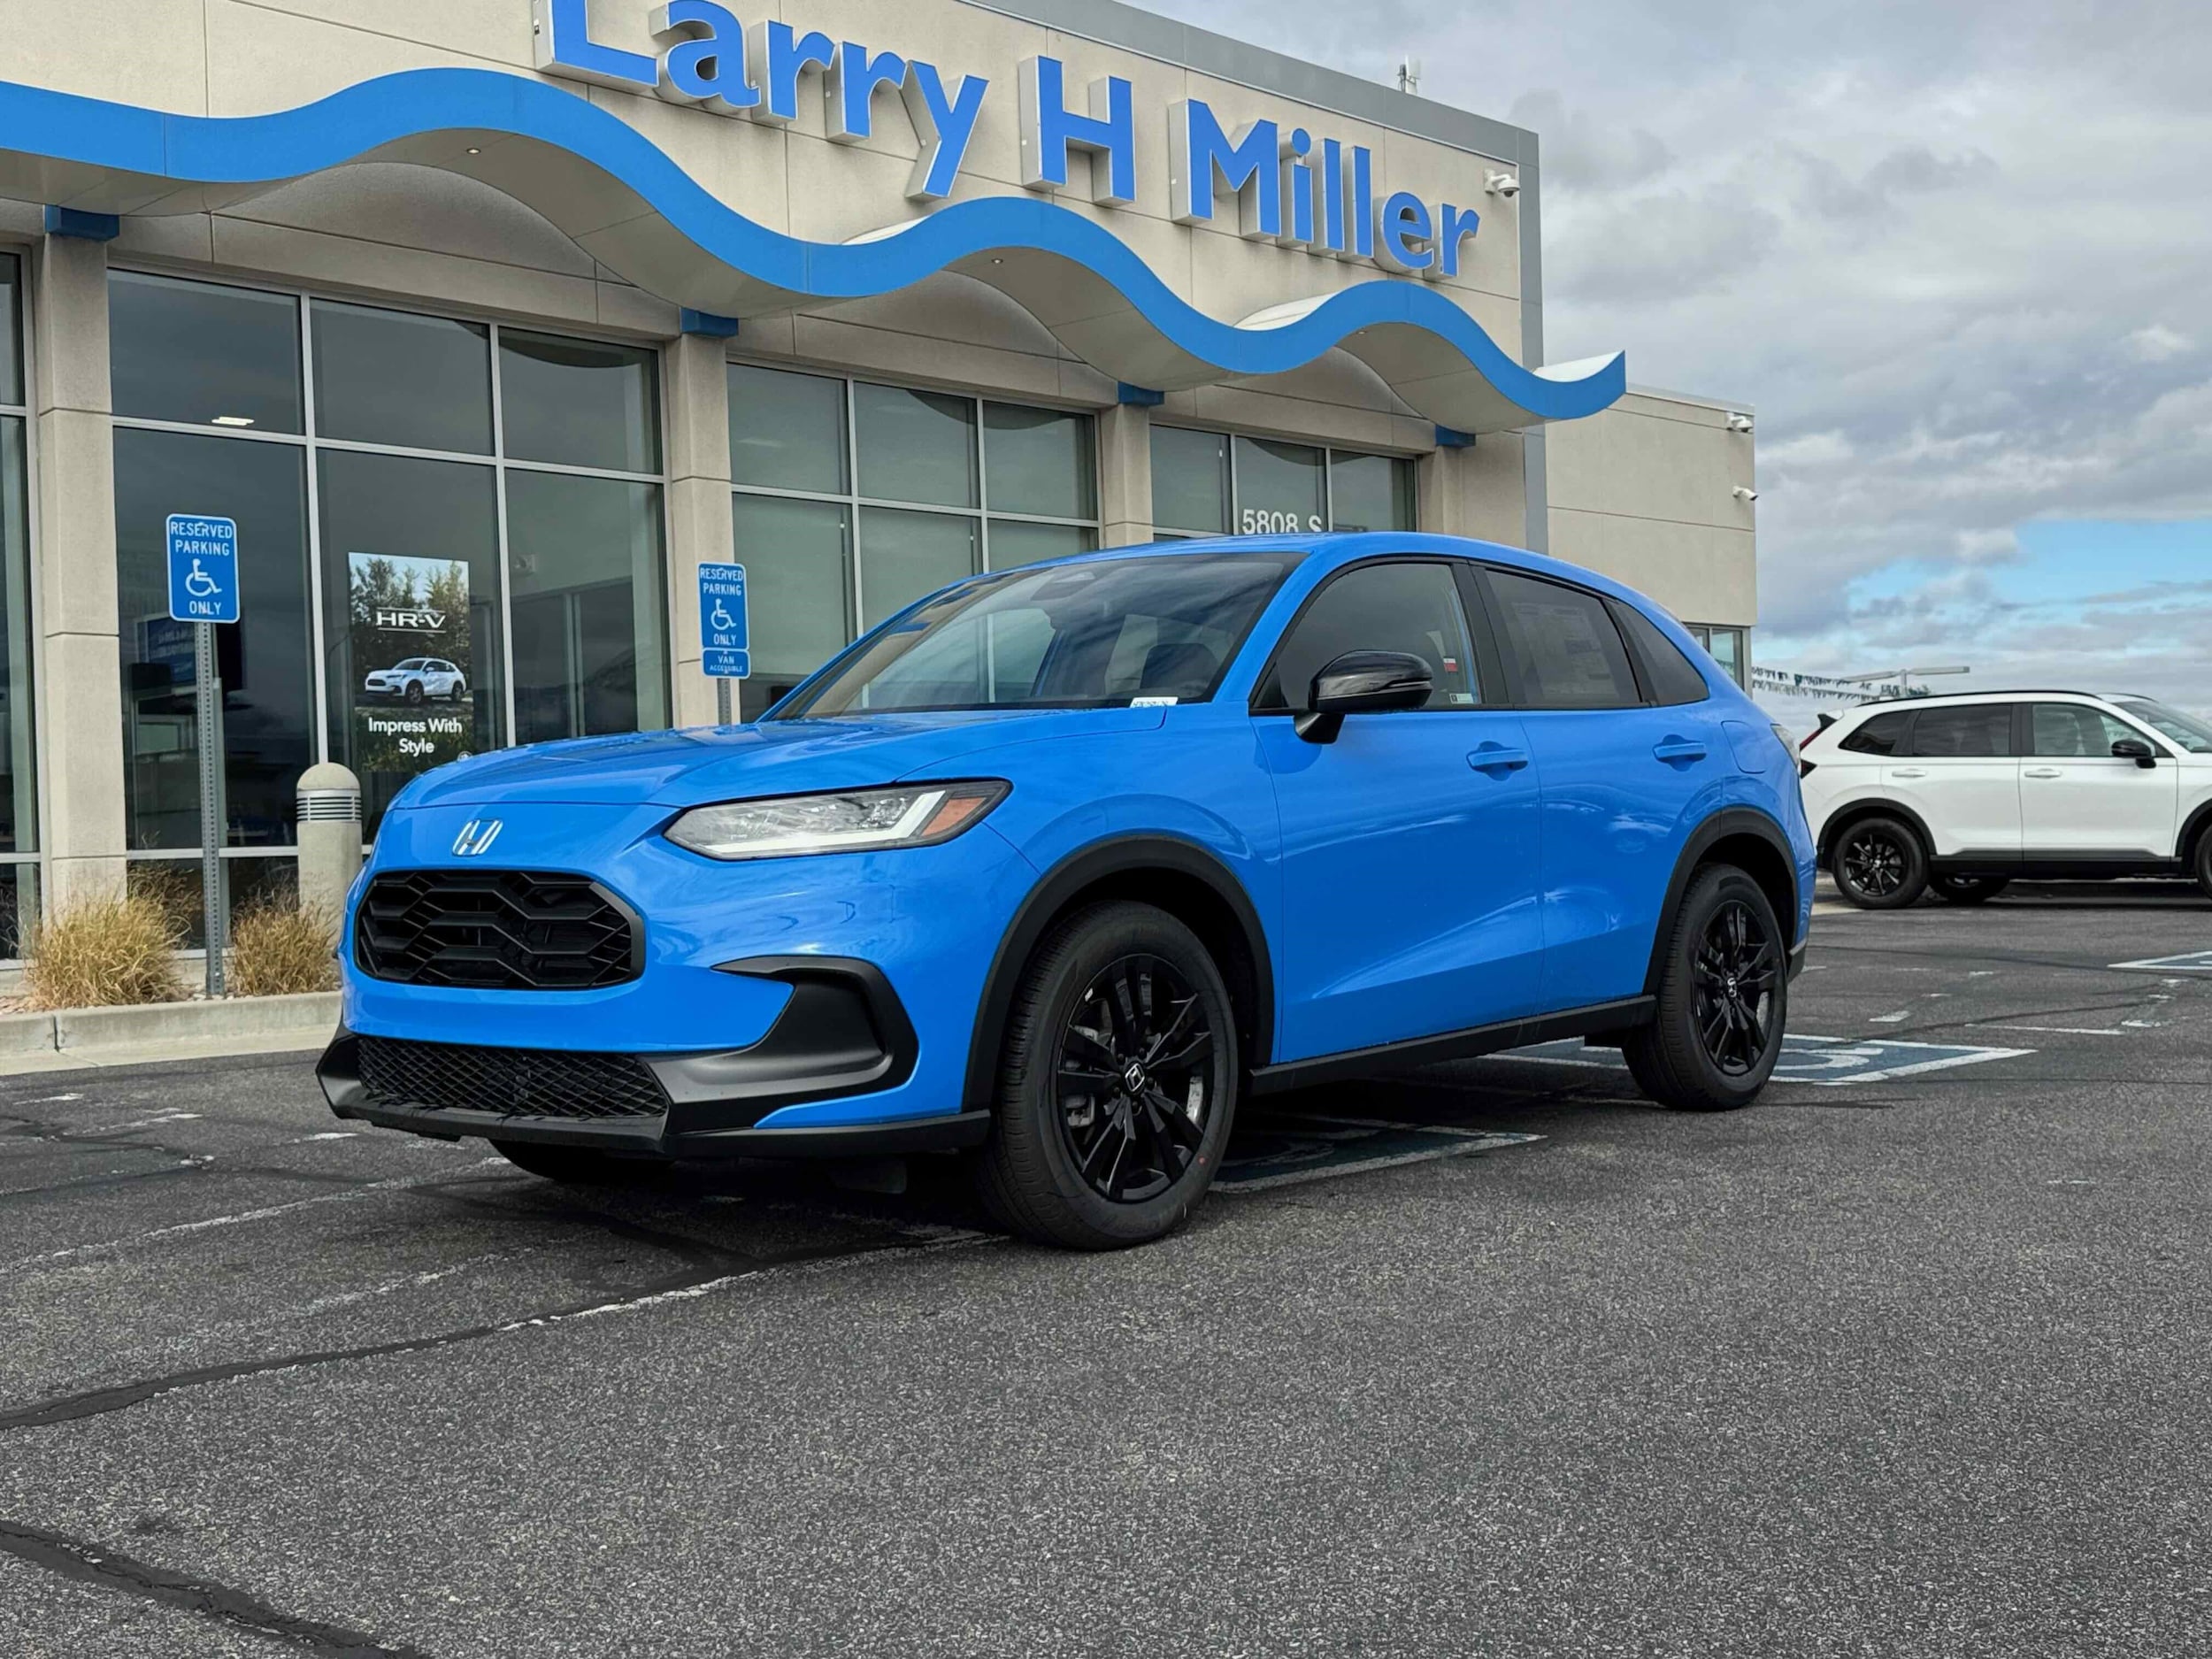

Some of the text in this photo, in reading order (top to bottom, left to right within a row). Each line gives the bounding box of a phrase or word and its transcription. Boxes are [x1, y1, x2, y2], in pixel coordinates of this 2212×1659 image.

[549, 0, 1480, 279] Larry H Miller
[170, 521, 233, 539] RESERVED
[1241, 508, 1300, 534] 5808
[174, 539, 230, 557] PARKING
[699, 566, 744, 582] RESERVED
[703, 582, 742, 596] PARKING
[188, 600, 222, 616] ONLY
[375, 611, 447, 629] HR-V
[712, 633, 737, 646] ONLY
[717, 655, 735, 664] VAN
[367, 717, 464, 736] Impress With
[398, 737, 435, 758] Style
